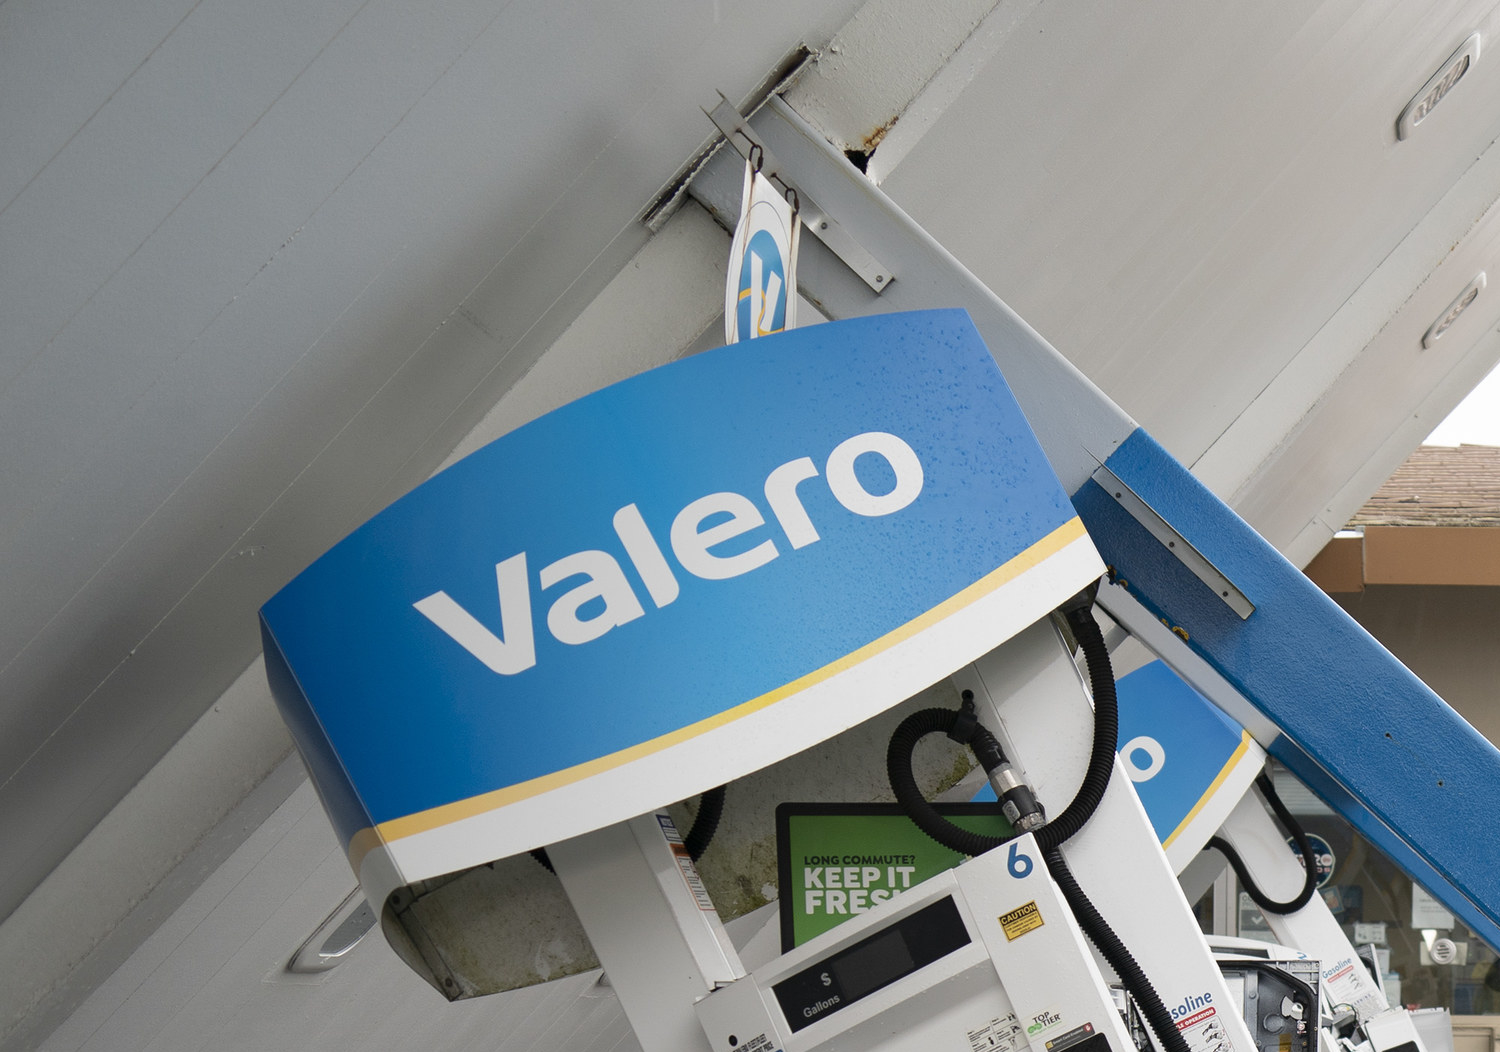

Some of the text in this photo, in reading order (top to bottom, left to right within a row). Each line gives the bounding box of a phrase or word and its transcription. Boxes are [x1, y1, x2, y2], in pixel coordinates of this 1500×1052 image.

[412, 431, 924, 675] Valero
[804, 855, 915, 865] LONG COMMUTE?
[1007, 842, 1033, 879] 6
[804, 867, 915, 888] KEEP IT
[1002, 903, 1036, 925] CAUTION
[1323, 958, 1352, 978] Gasoline
[821, 973, 831, 986] $
[803, 995, 840, 1018] Gallons
[1171, 992, 1212, 1019] soline
[1032, 1012, 1049, 1024] TOP
[1042, 1014, 1061, 1027] TIER
